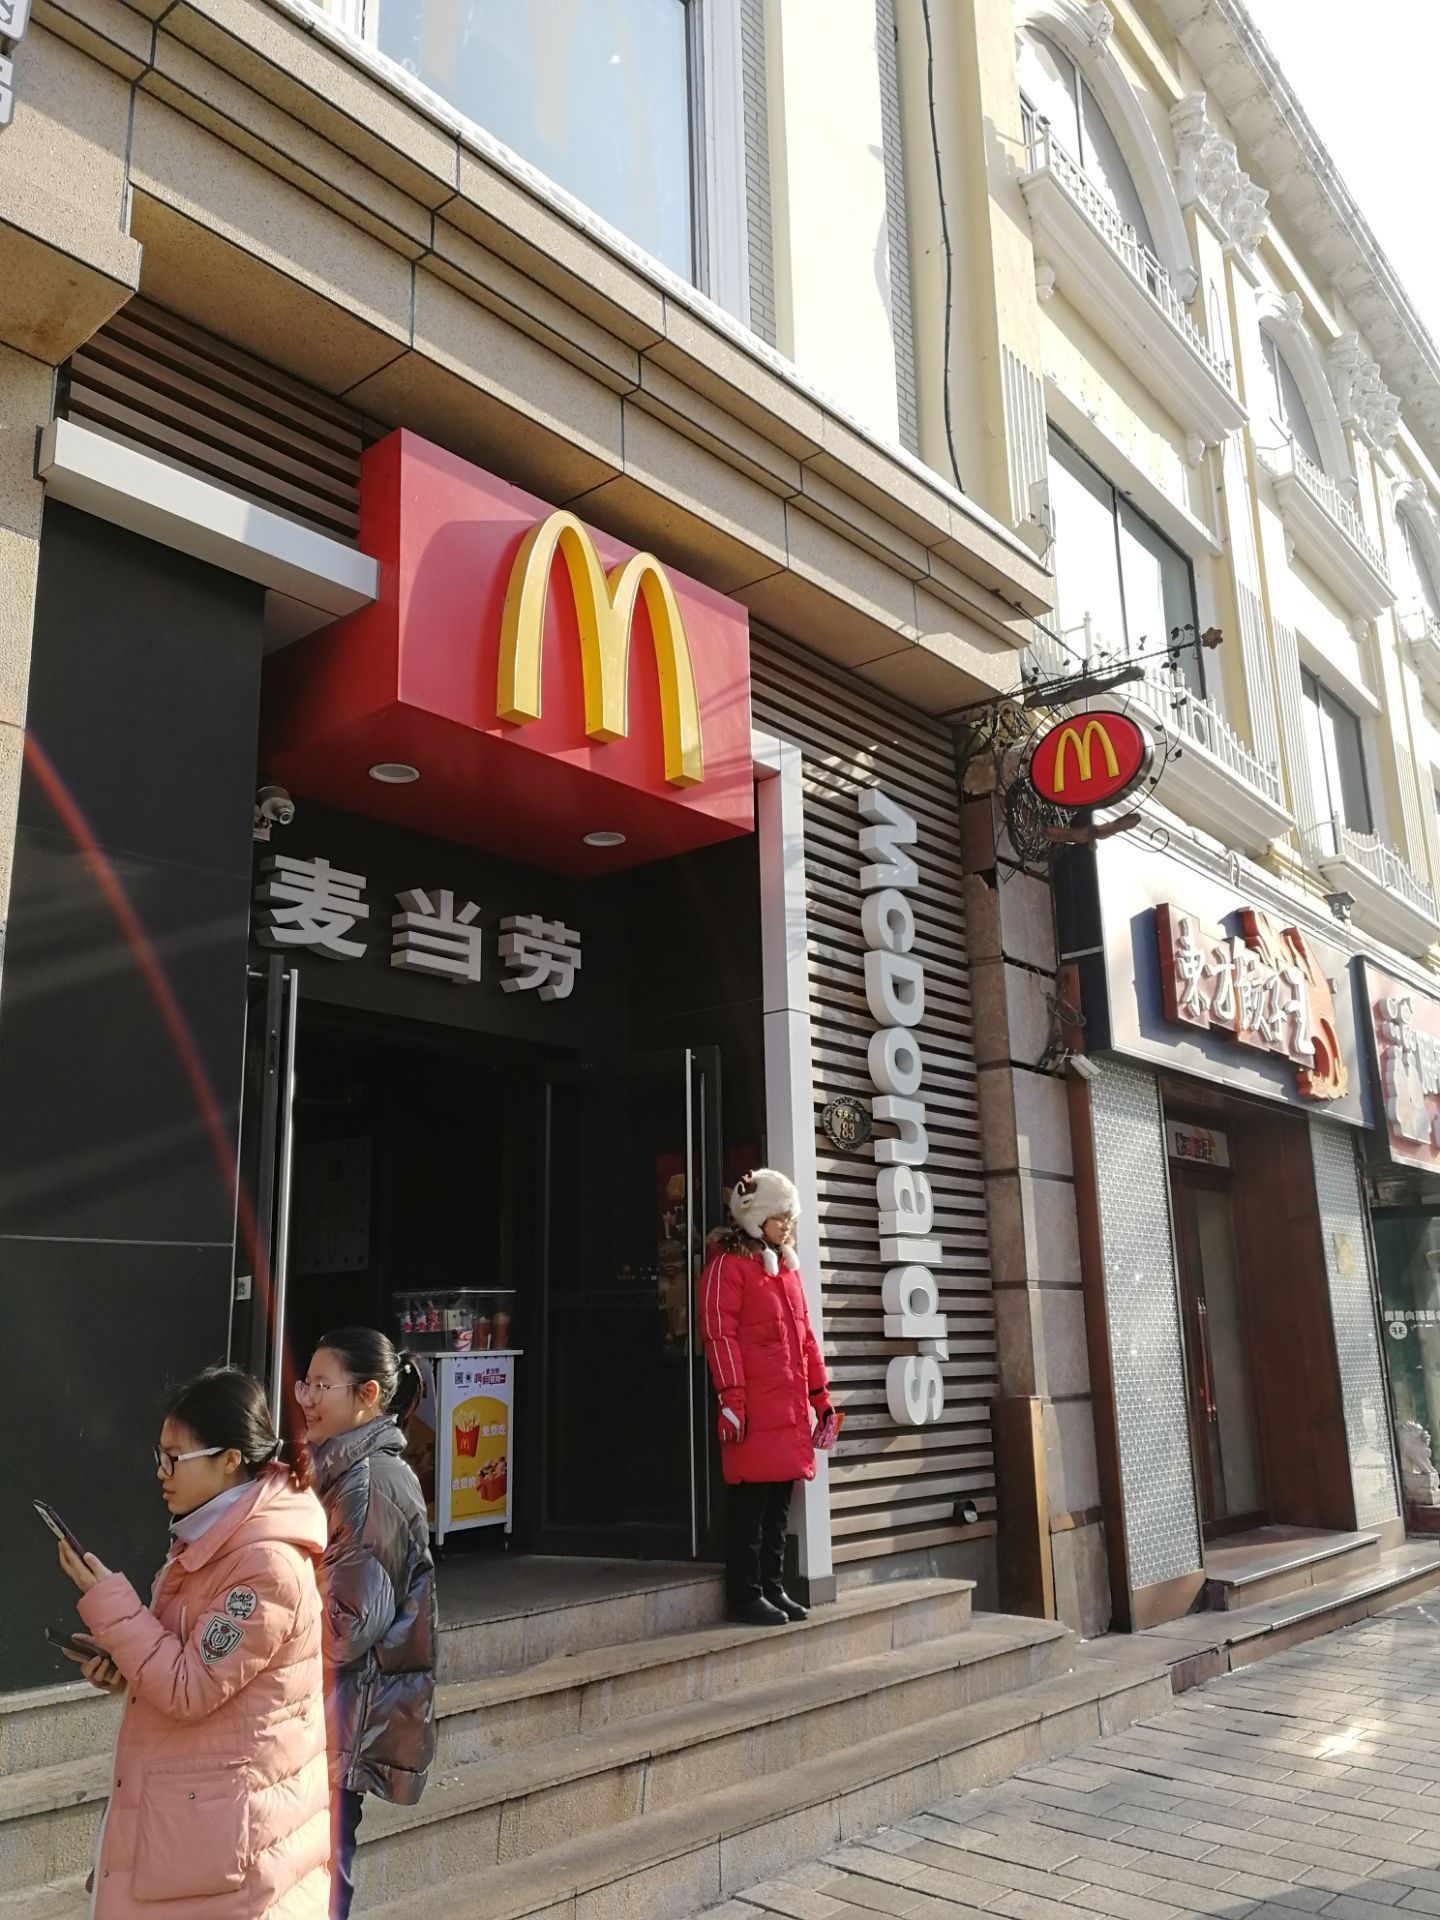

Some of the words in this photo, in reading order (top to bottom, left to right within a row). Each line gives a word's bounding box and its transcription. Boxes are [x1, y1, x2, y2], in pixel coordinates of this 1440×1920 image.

[255, 854, 582, 1001] 麦当劳
[842, 1121, 856, 1140] 83
[858, 787, 949, 1425] McDonald's
